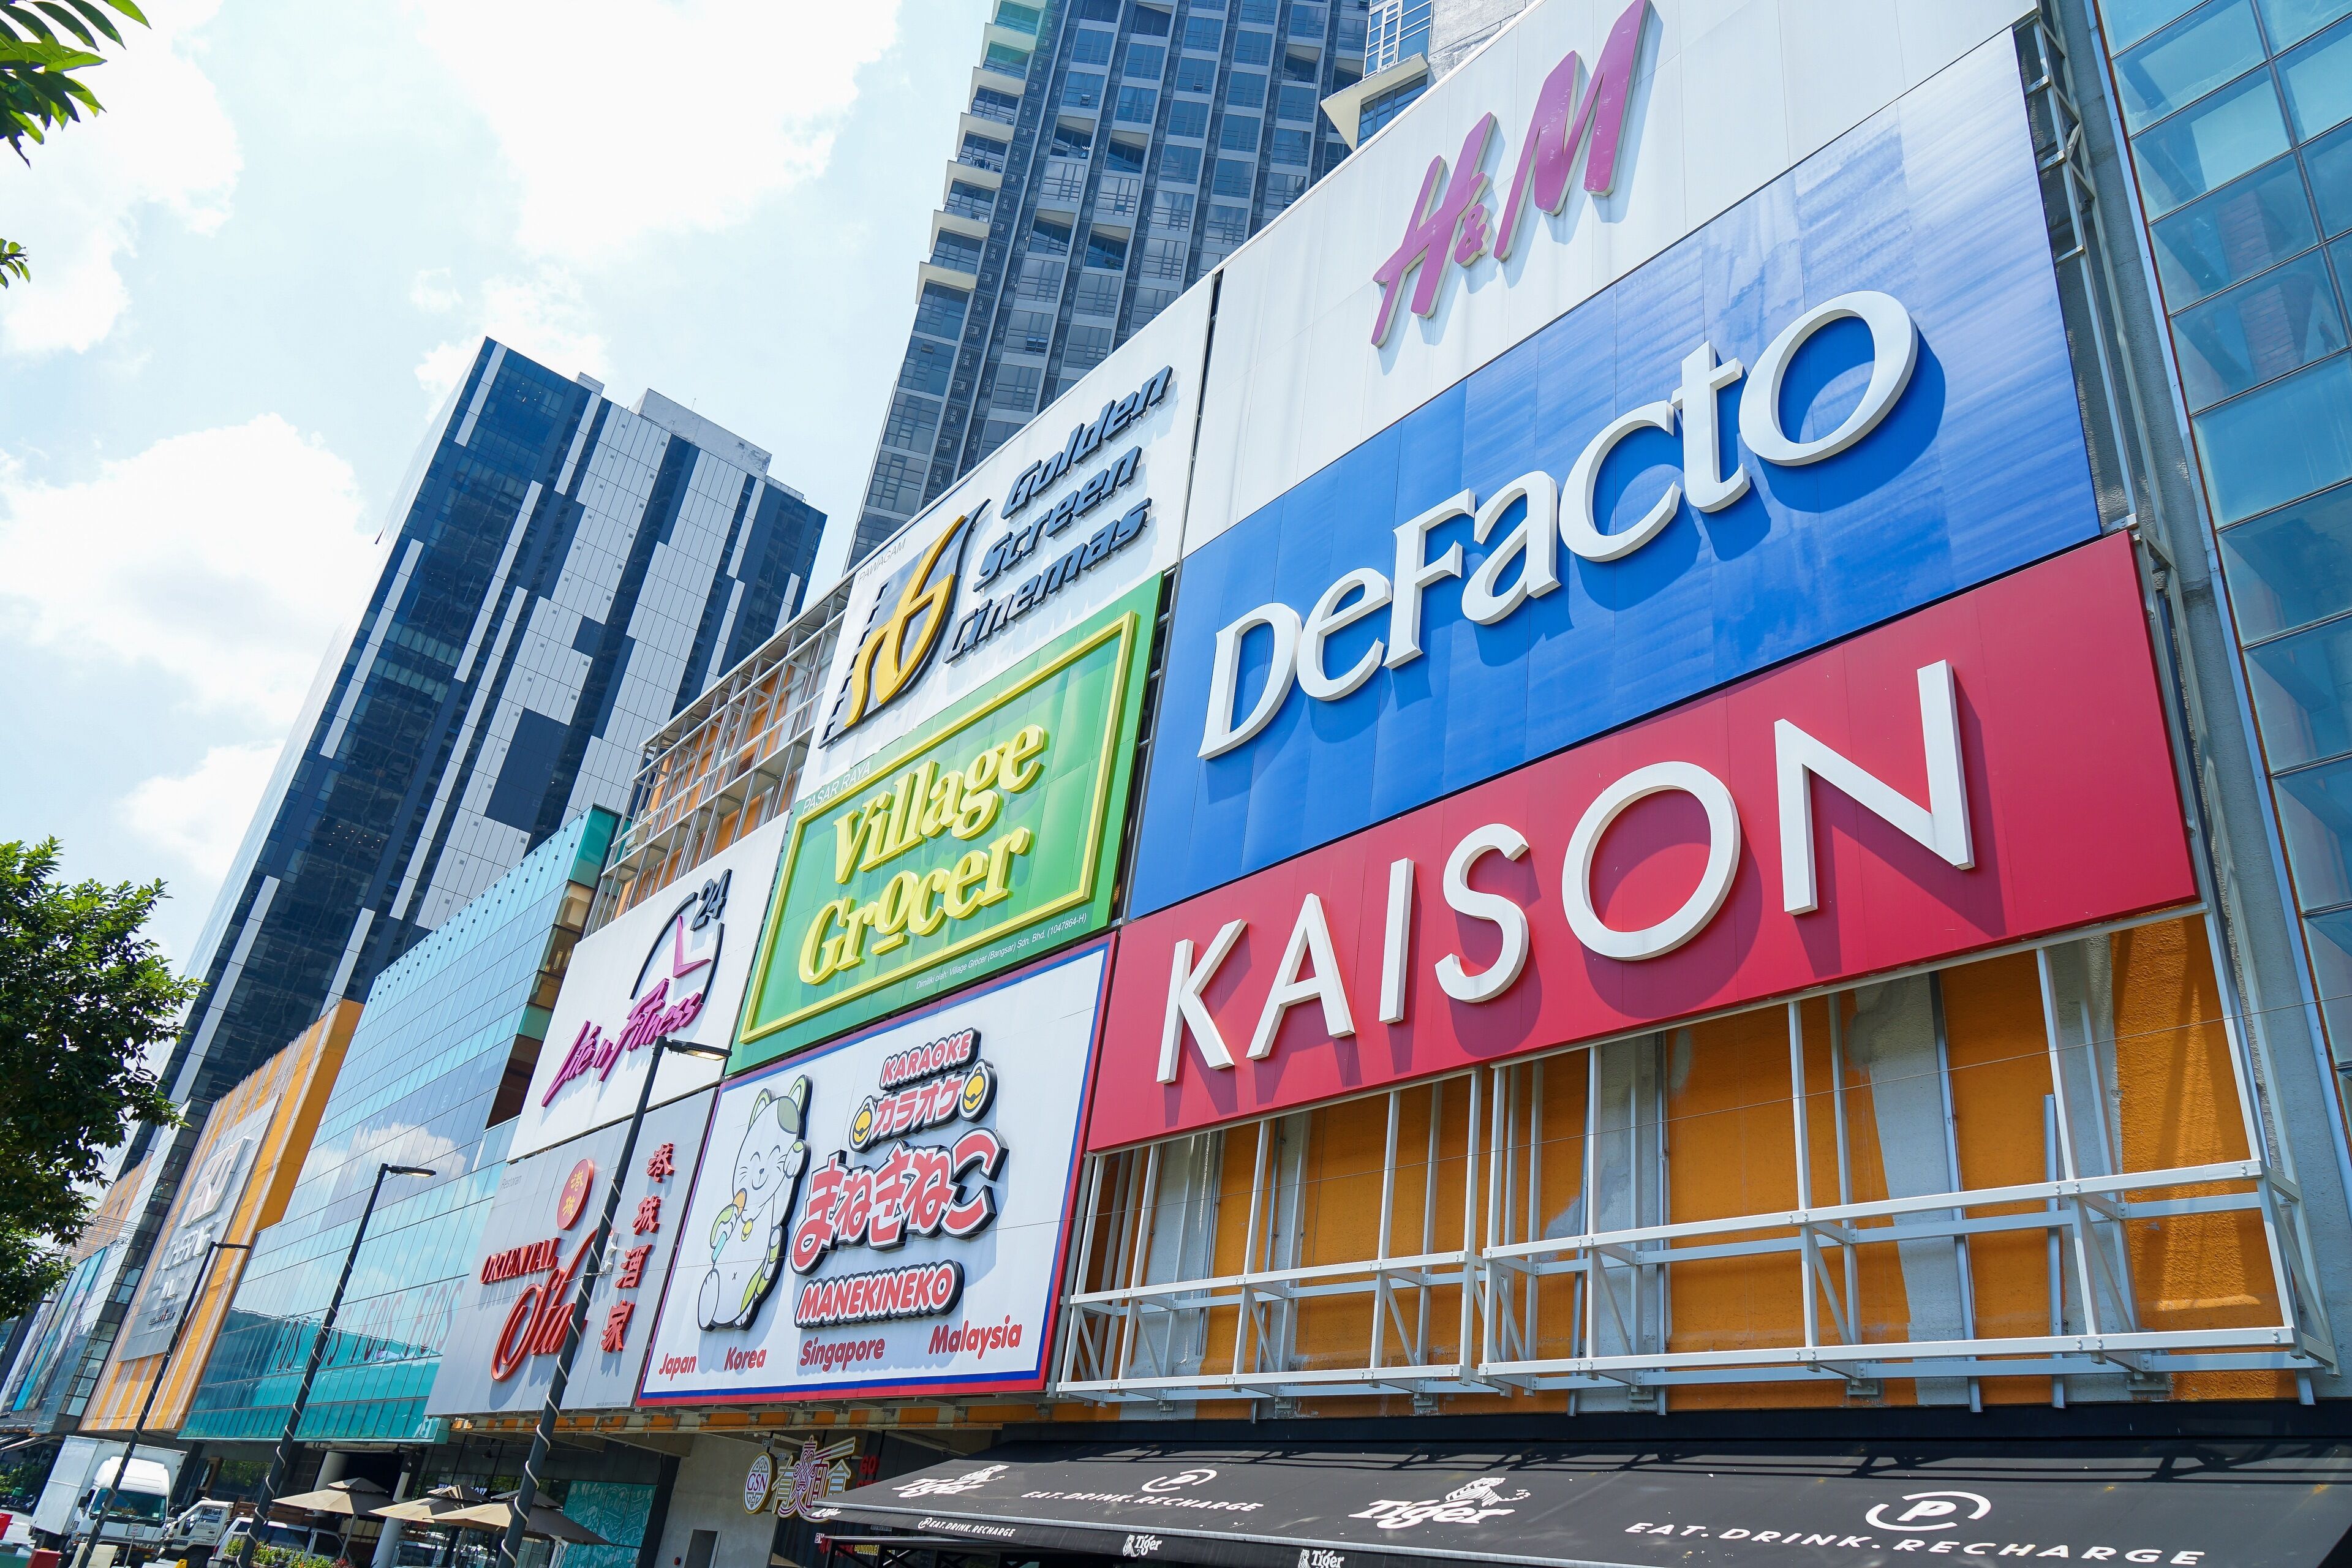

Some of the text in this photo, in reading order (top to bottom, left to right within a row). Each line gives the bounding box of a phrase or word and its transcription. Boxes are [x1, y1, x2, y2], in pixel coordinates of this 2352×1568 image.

[1372, 0, 1653, 347] H&M
[1000, 365, 1172, 519] Golden
[973, 446, 1142, 592] Screen
[1197, 291, 1920, 760] DeFacto
[858, 537, 907, 585] PAWAGAM
[943, 499, 1152, 664] Cinemas
[802, 761, 870, 815] PASAR RAYA
[834, 724, 1045, 884] Village
[690, 869, 732, 931] 24
[1156, 660, 1975, 1084] KAISON
[797, 826, 1030, 987] Grocer
[935, 971, 948, 982] oleh:
[949, 964, 967, 976] Village
[968, 956, 988, 968] Grocer
[987, 941, 1016, 962] (Bangsar)
[1017, 937, 1030, 949] Sdn.
[1031, 930, 1046, 943] Bhd.
[598, 978, 703, 1082] Fitness
[881, 1031, 973, 1087] KARAOKE
[873, 1072, 963, 1137] カラオケ
[792, 1133, 1001, 1270] まねきねこ
[480, 1237, 562, 1284] ORIENTAL
[600, 1143, 675, 1353] 港城酒家
[798, 1264, 952, 1322] MANEKINEKO
[659, 1315, 1023, 1382] Japan Korea Singapore Malaysia
[892, 1478, 985, 1498] Tiger
[1348, 1499, 1515, 1529] Tiger
[1134, 1534, 1163, 1556] Tiger
[1311, 1549, 1344, 1568] Tiger
